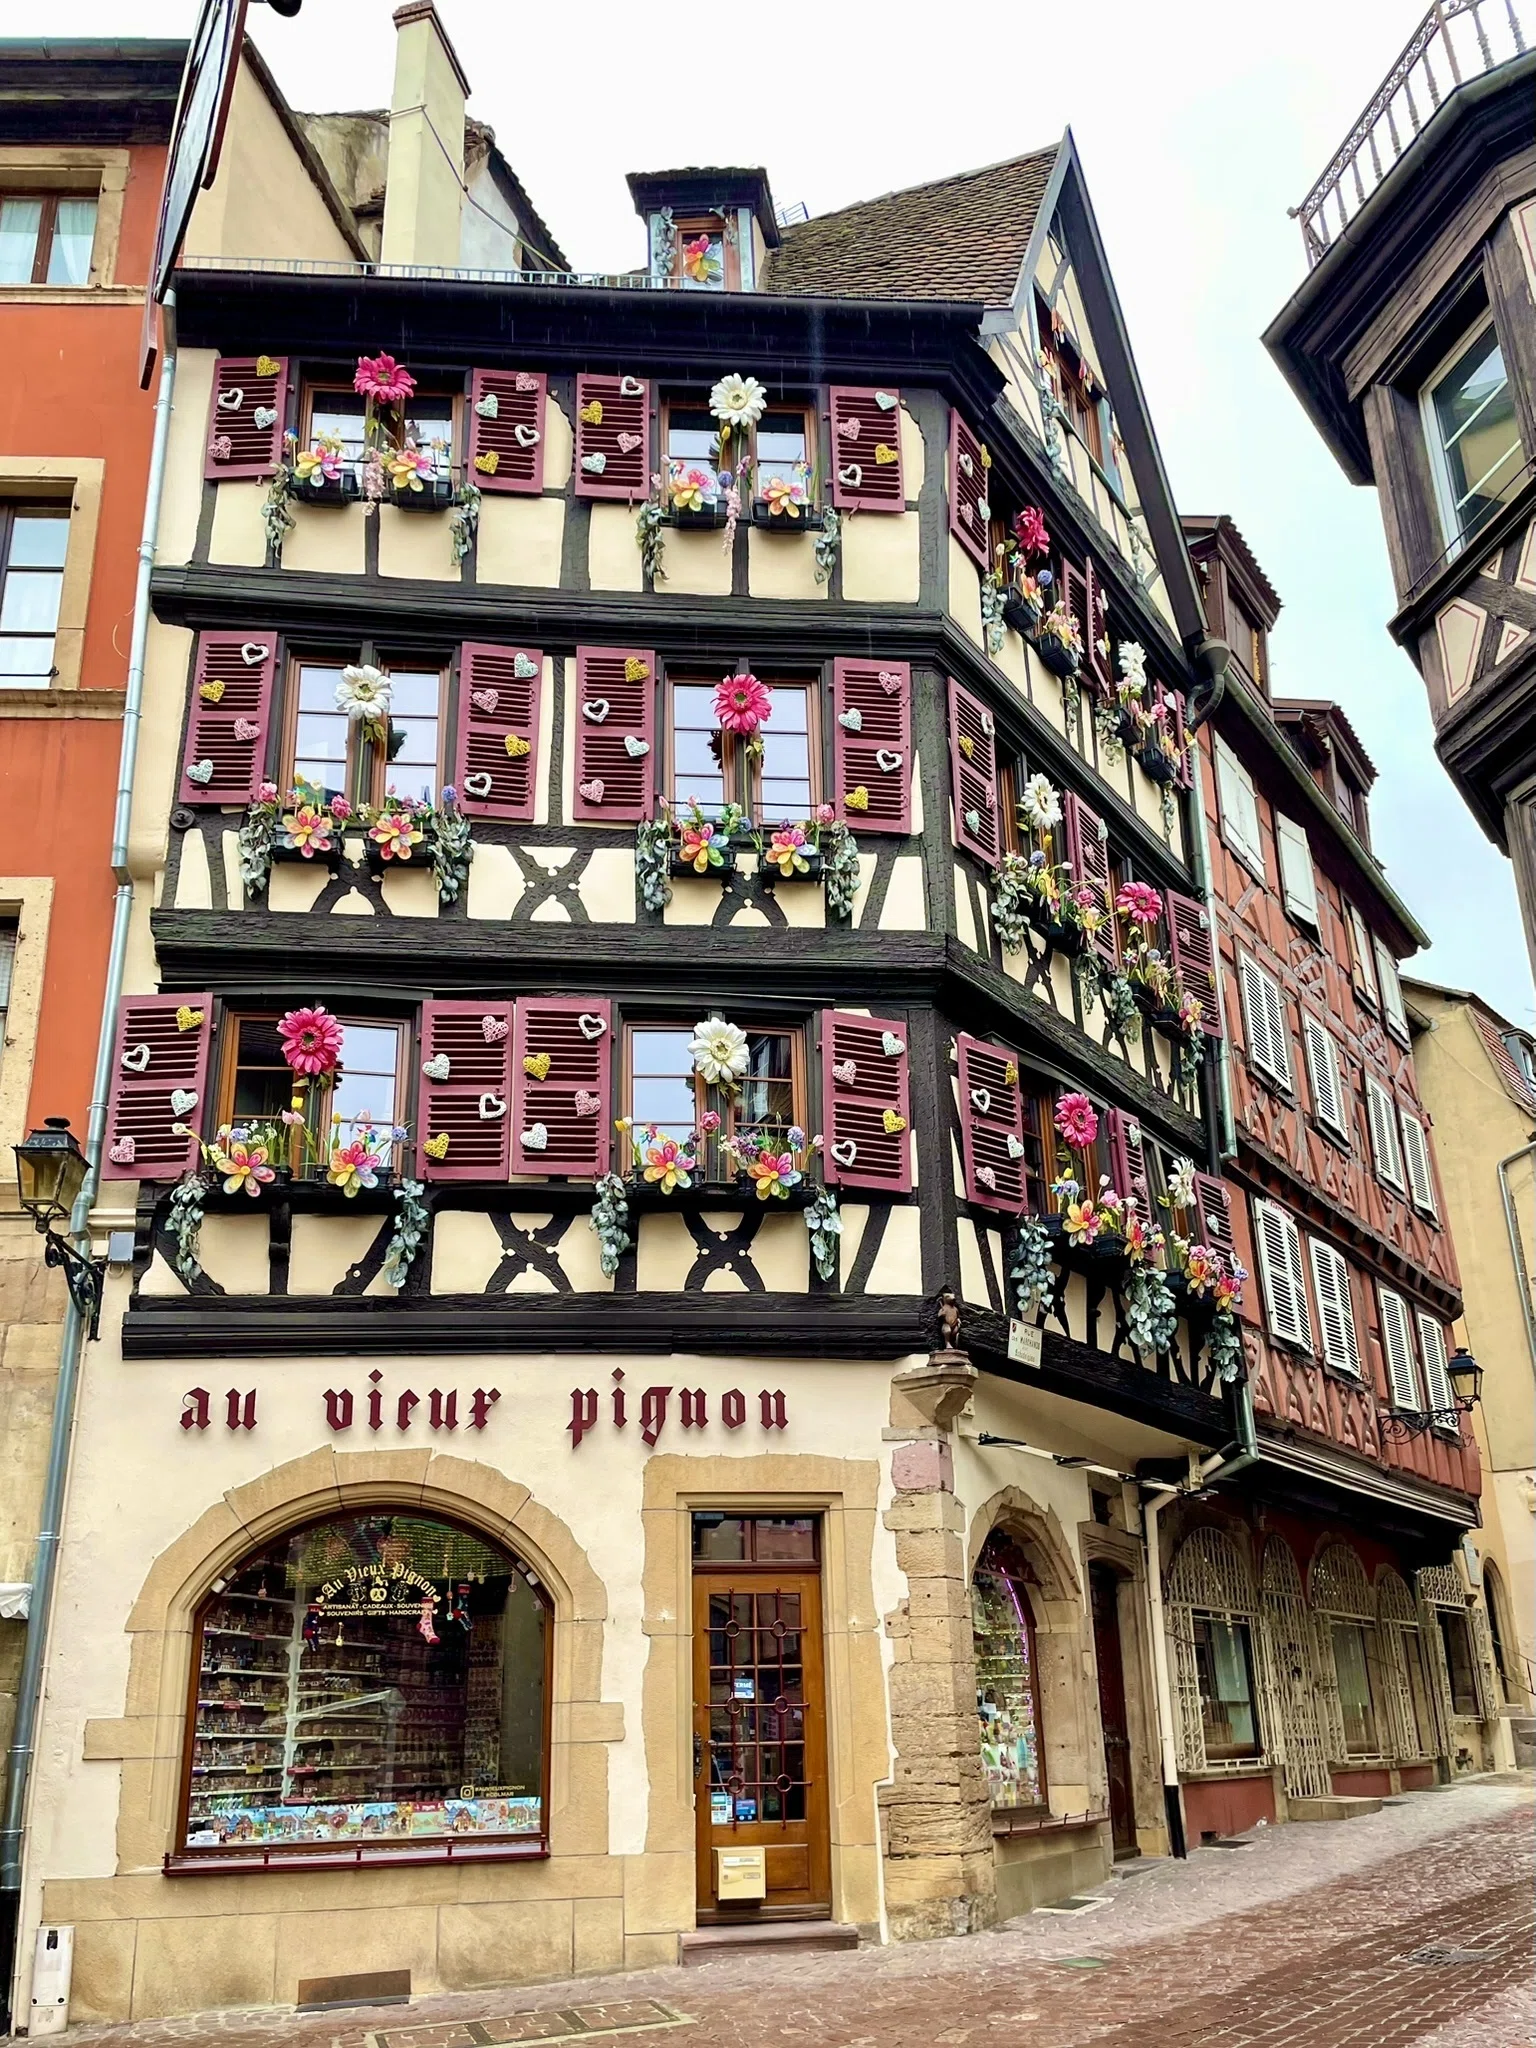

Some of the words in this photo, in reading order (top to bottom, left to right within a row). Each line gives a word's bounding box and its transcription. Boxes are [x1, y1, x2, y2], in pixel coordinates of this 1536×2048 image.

[179, 1386, 258, 1432] au
[322, 1368, 500, 1433] vieux
[567, 1366, 790, 1450] pignon
[321, 1578, 344, 1600] Au
[344, 1563, 386, 1582] Vieux
[391, 1561, 438, 1597] Pignon
[327, 1609, 363, 1617] SOUVENIRS
